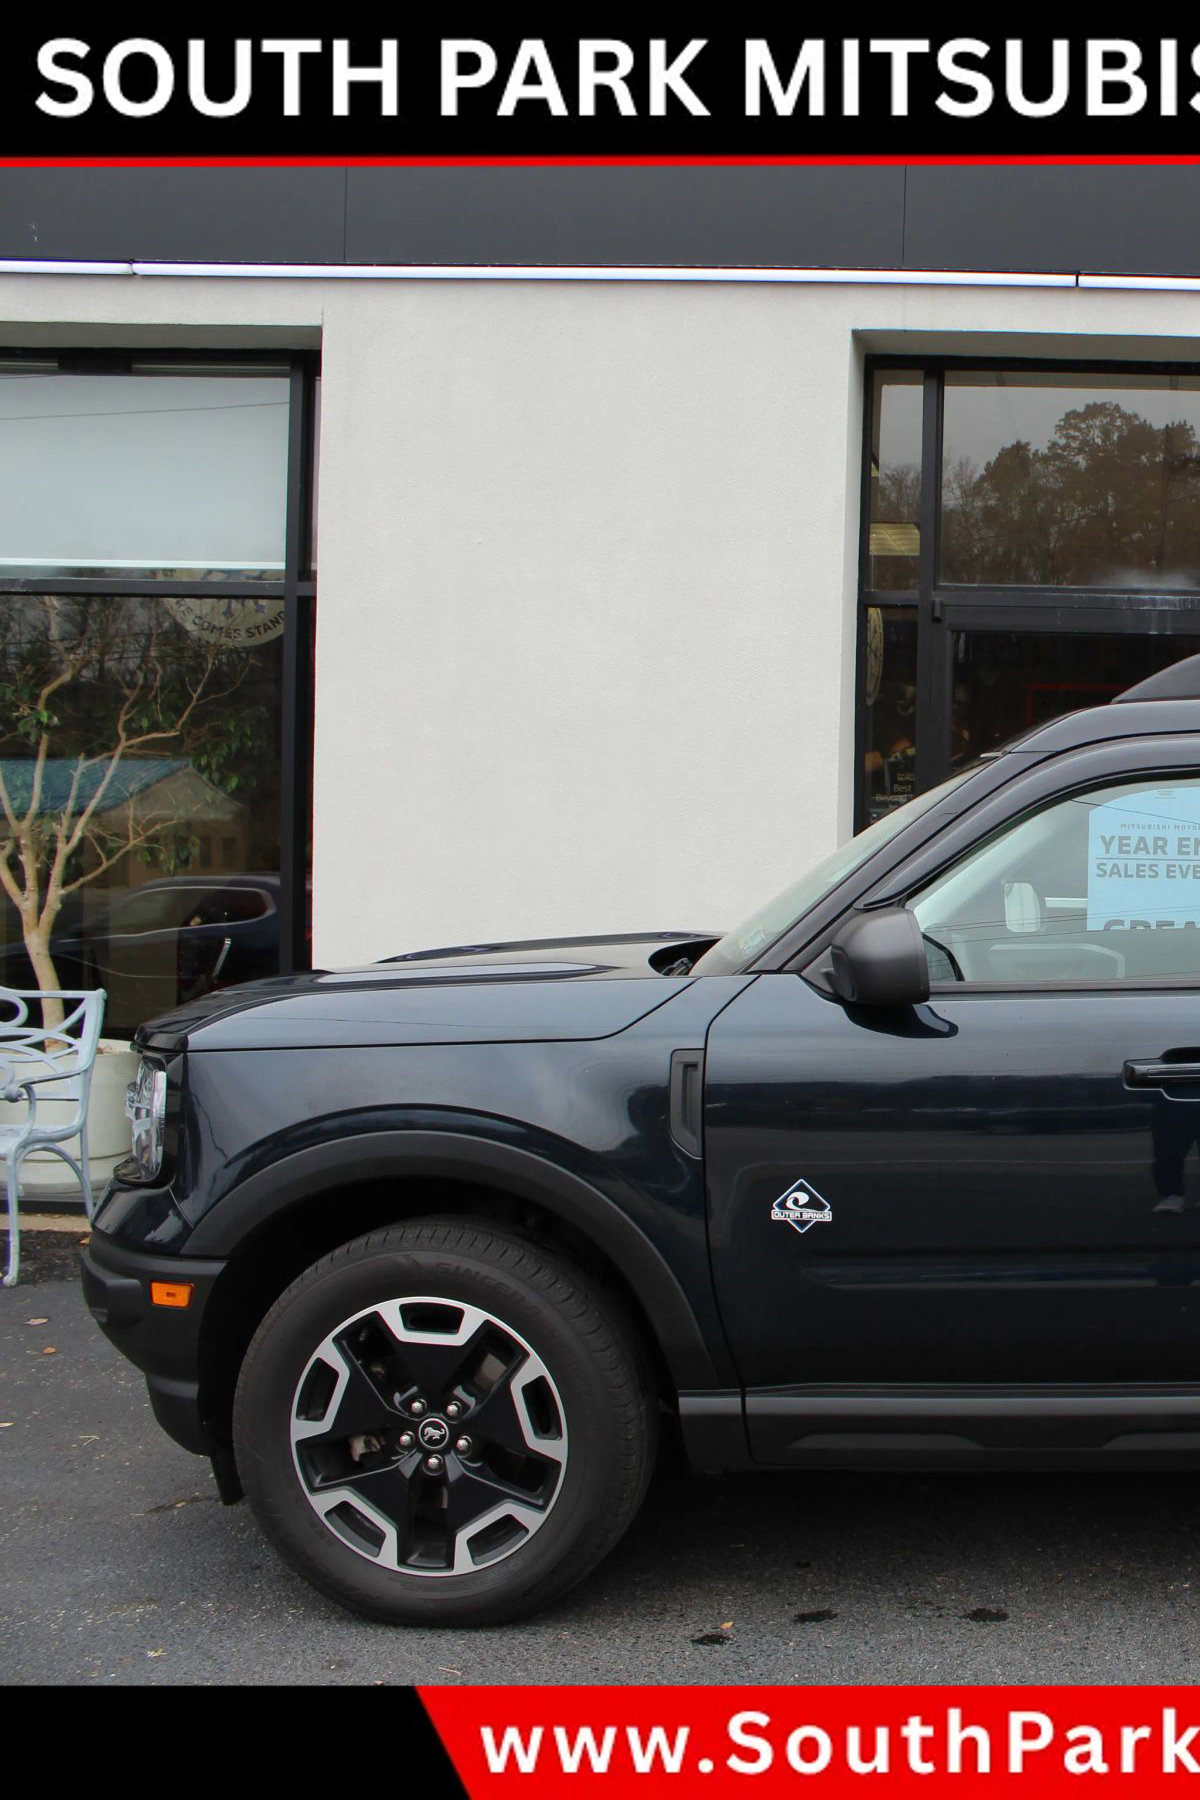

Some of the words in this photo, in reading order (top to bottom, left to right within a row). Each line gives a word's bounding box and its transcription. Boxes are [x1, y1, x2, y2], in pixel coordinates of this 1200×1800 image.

[1120, 823, 1170, 831] MITSUBISHI
[1100, 835, 1169, 856] YEAR
[1096, 862, 1159, 879] SALES
[774, 1211, 801, 1219] OUTER
[802, 1211, 830, 1220] BANKS
